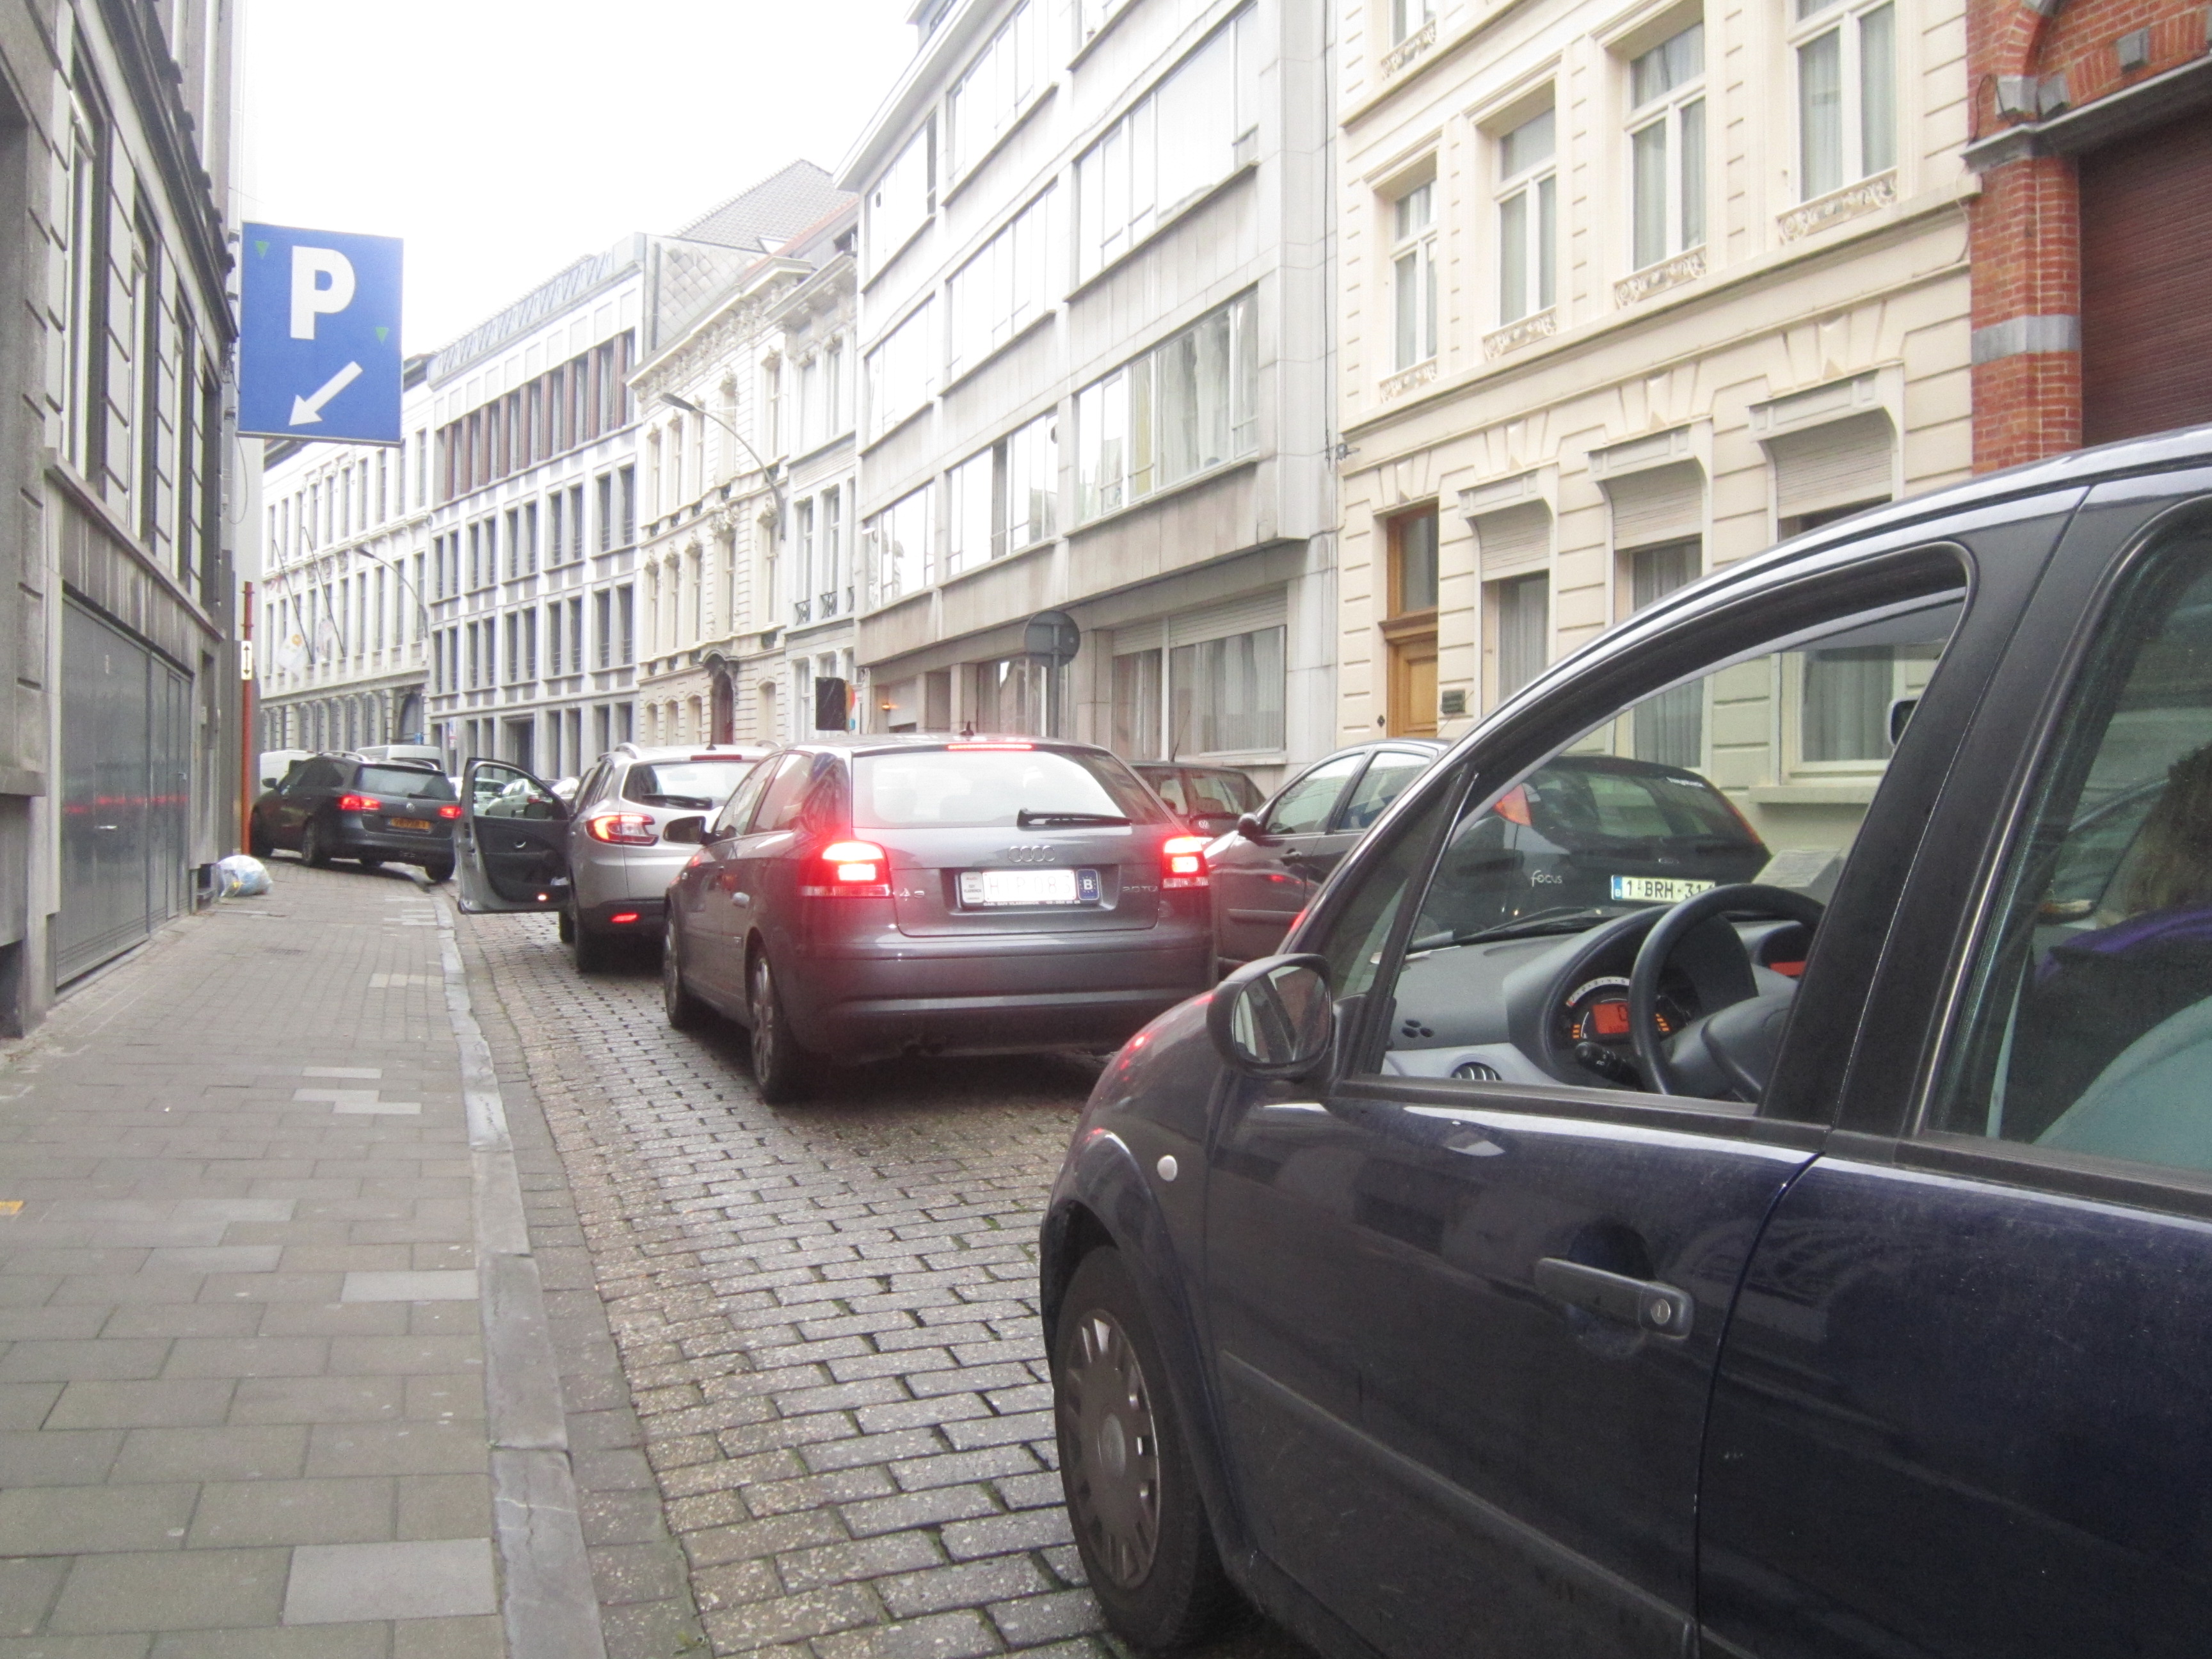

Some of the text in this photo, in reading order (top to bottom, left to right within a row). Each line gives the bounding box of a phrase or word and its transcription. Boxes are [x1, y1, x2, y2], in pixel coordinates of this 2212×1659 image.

[290, 245, 356, 340] P
[988, 876, 1026, 895] HIP
[1083, 878, 1093, 890] B
[1626, 879, 1713, 899] 1-BRH-31
